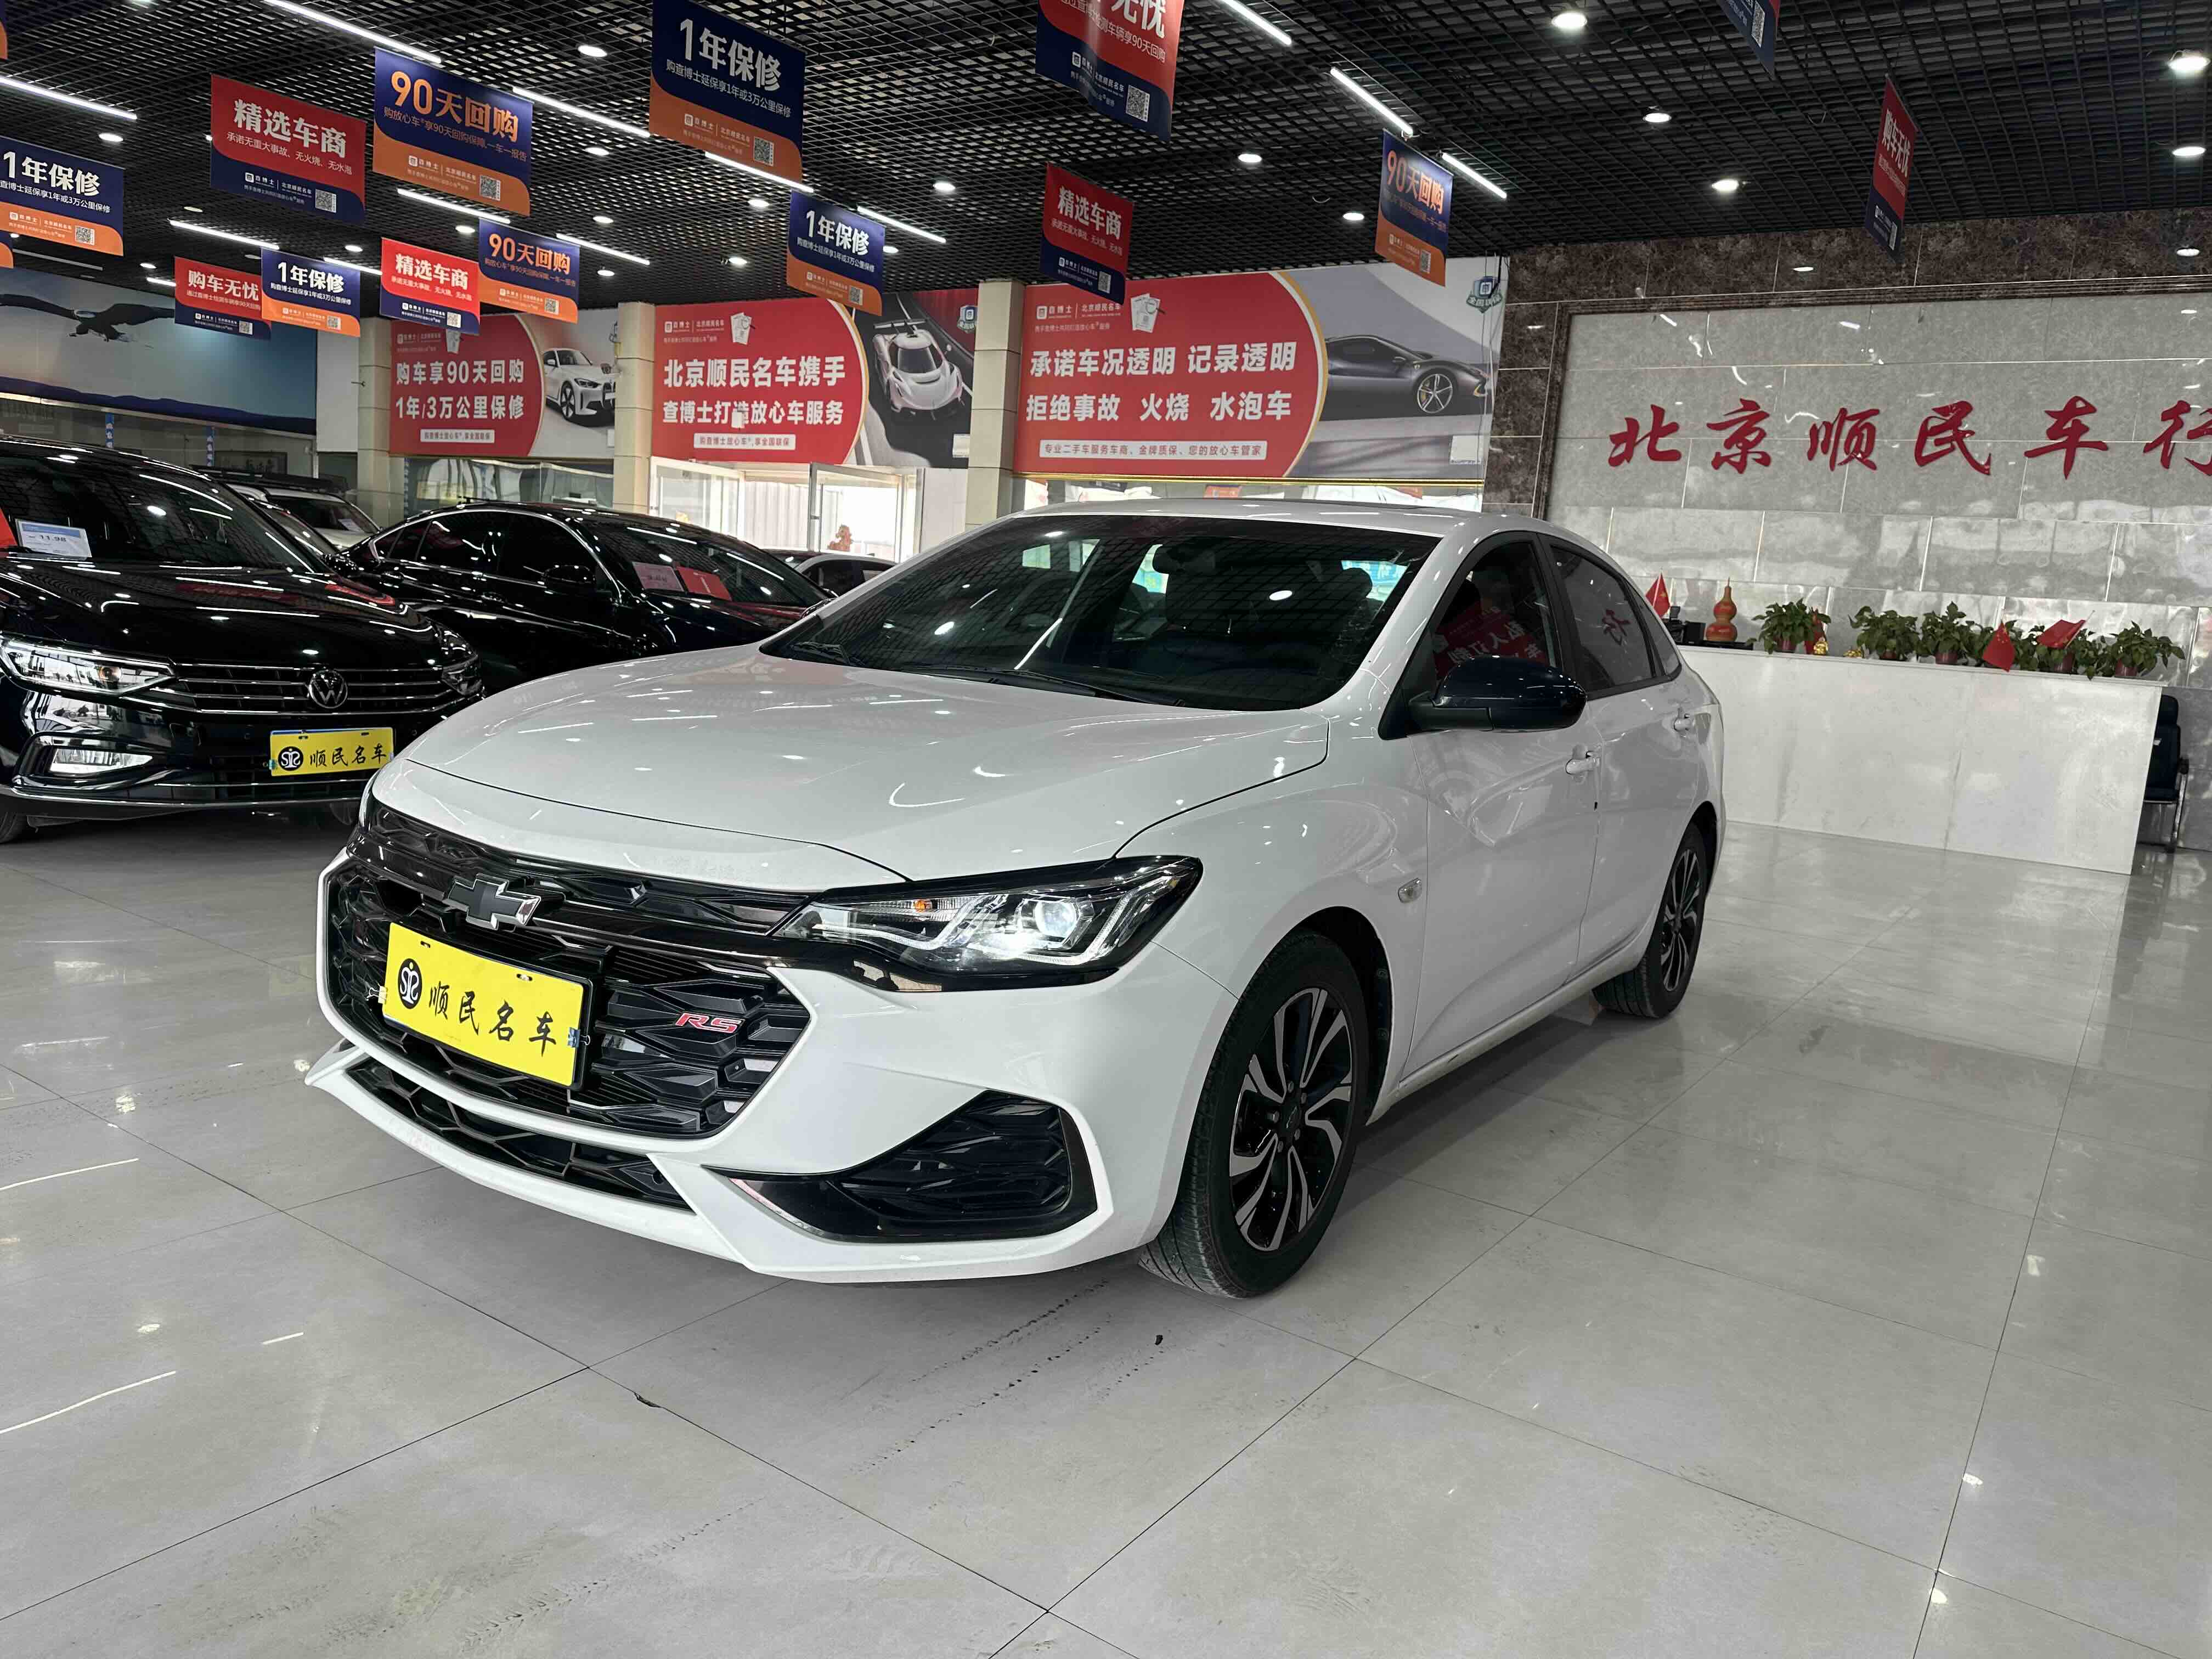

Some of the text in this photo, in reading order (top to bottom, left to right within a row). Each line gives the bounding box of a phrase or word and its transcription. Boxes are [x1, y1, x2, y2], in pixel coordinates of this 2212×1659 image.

[680, 18, 781, 91] 1年保修
[391, 71, 518, 142] 90天回购
[666, 59, 791, 118] 购查博士延保享1年或3万公里保修
[234, 99, 346, 159] 精选车商
[3, 151, 100, 196] 1年保修
[1387, 150, 1444, 214] 90天回购
[1058, 185, 1121, 240] 精选车商
[806, 210, 870, 255] 1年保修
[396, 253, 468, 290] 精选车商
[489, 233, 571, 274] 90天回购
[188, 270, 259, 301] 购车无忧
[278, 262, 344, 294] 1年保修
[396, 358, 524, 385] 购车享90天回购
[663, 356, 846, 387] 北京顺民名车携手
[1030, 341, 1297, 377] 承诺车况透明 记录透明
[396, 394, 524, 420] 1年/3万公里保修
[662, 400, 844, 425] 查博士打造放心车服务
[1026, 391, 1292, 422] 拒绝事故 火烧 水泡车
[1608, 395, 2212, 479] 北京顺民车行
[310, 743, 386, 768] 顺民名车
[428, 981, 556, 1057] 顺民名车
[675, 1013, 741, 1034] RS
